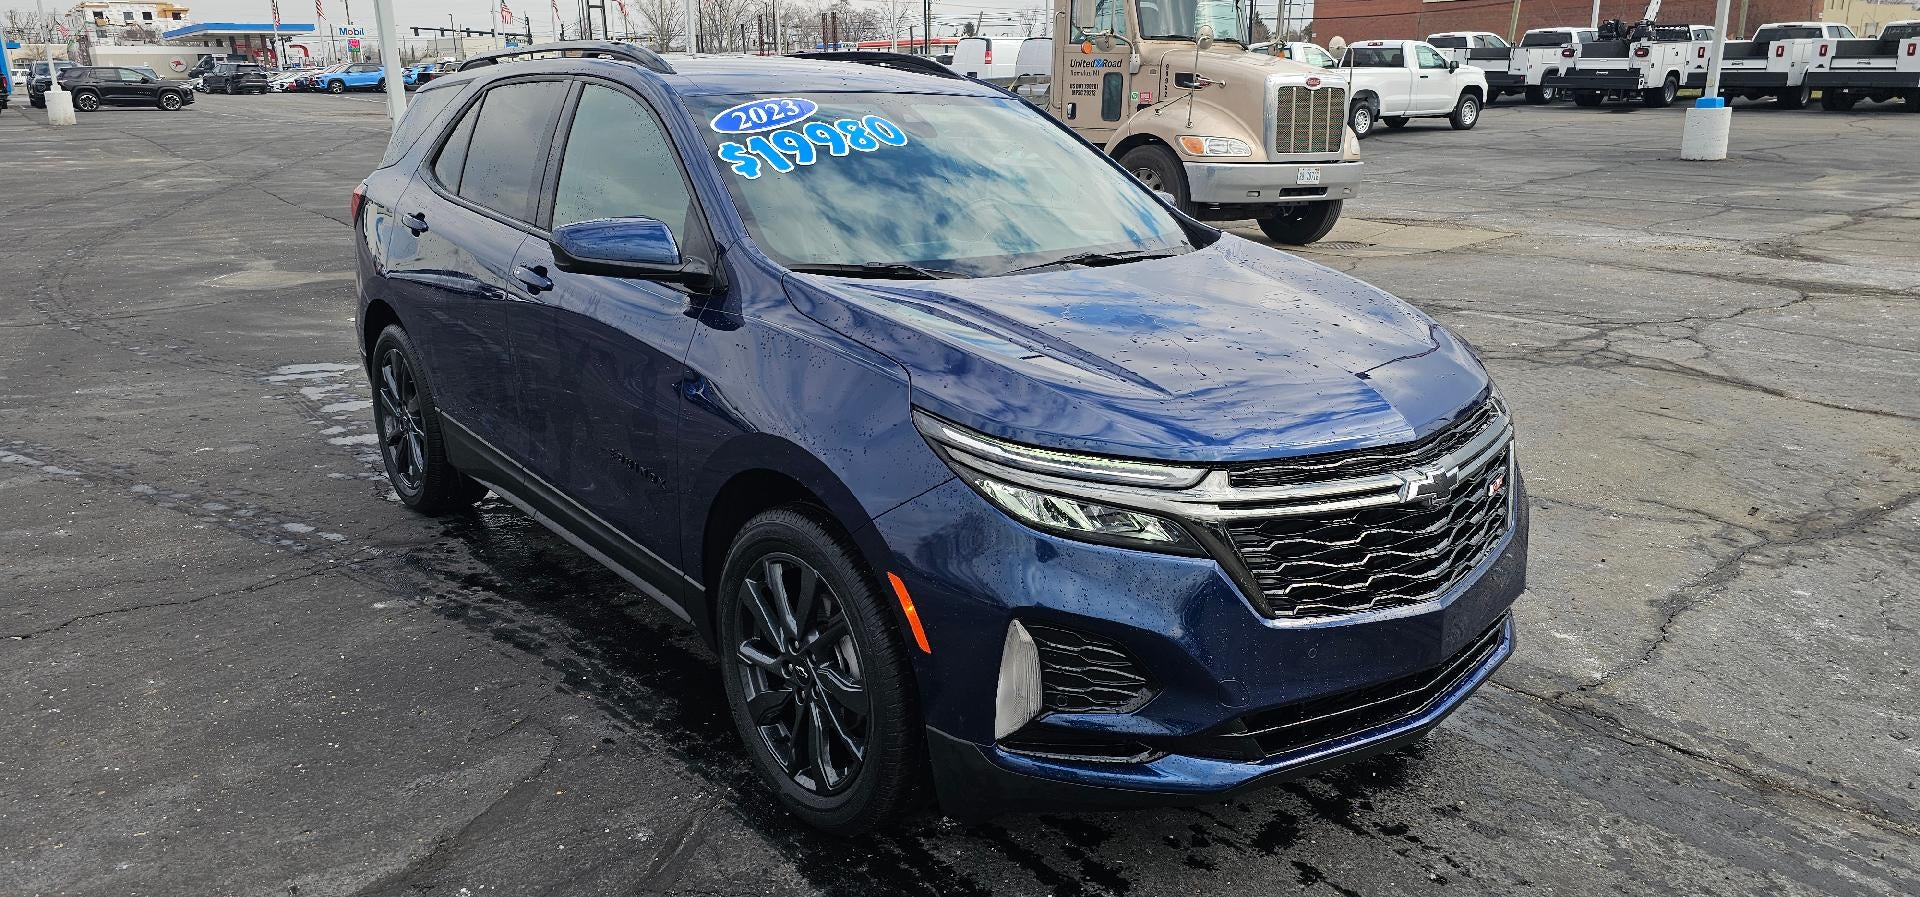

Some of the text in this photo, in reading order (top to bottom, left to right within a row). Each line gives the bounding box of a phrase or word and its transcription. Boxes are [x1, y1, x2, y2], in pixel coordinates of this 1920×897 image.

[339, 27, 365, 36] Mobil
[1070, 59, 1123, 68] United Road
[731, 99, 800, 130] 2023
[718, 115, 908, 180] $19980
